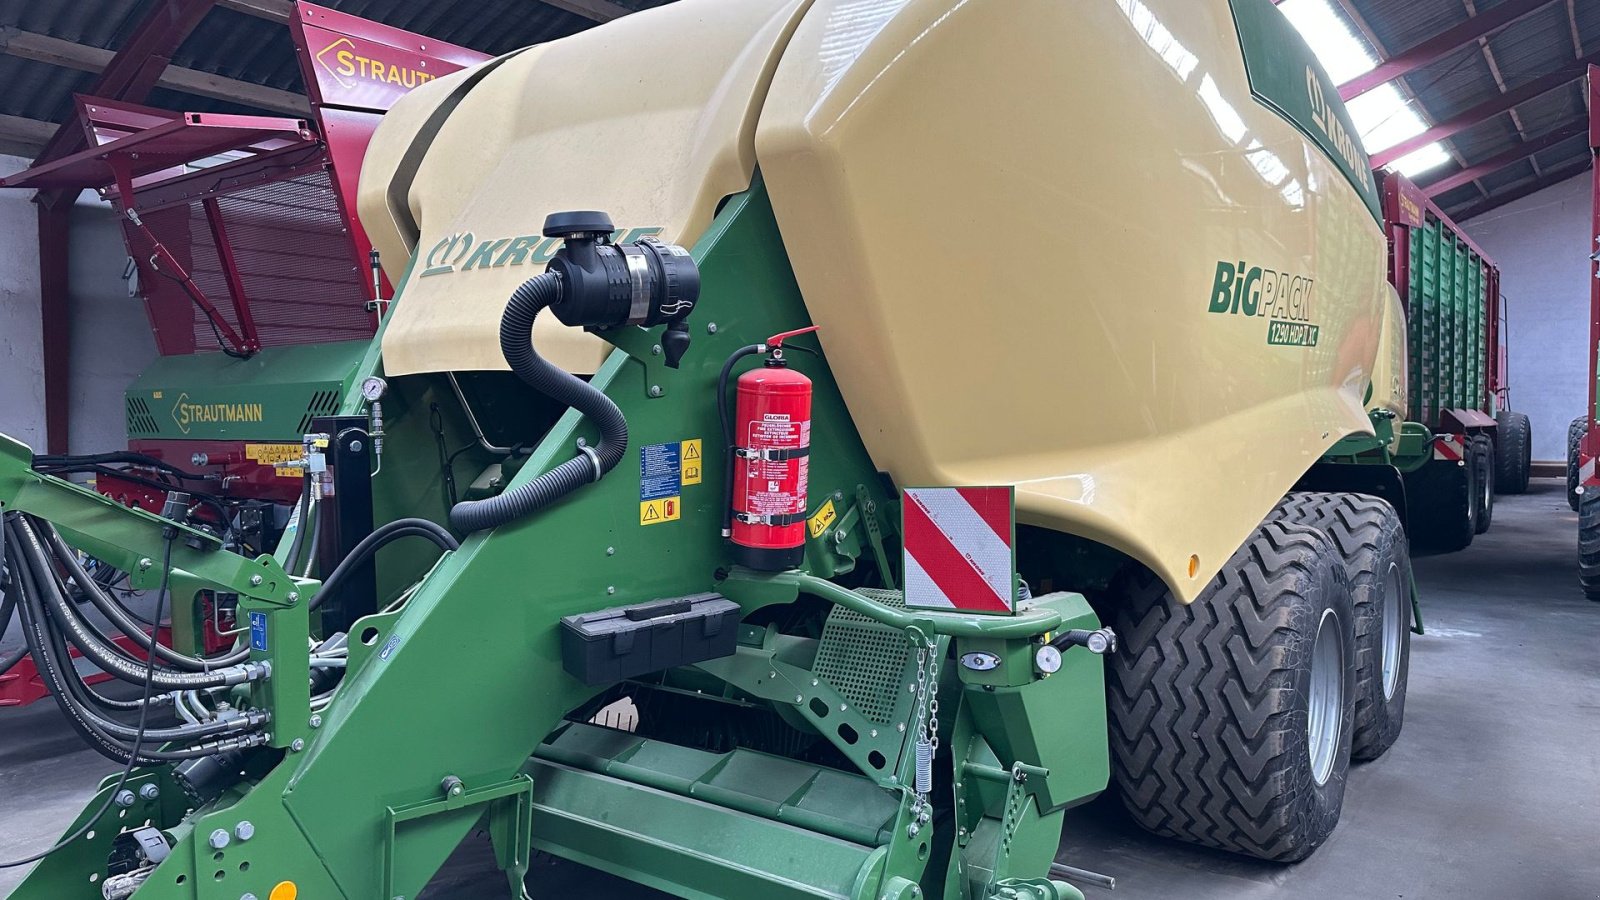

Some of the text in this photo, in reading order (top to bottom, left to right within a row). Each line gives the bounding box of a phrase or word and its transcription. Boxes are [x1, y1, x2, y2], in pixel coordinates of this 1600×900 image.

[337, 50, 438, 89] STRAUT
[1326, 104, 1370, 193] KRONE
[1271, 323, 1290, 343] 1290
[180, 403, 263, 424] STRAUTMANN
